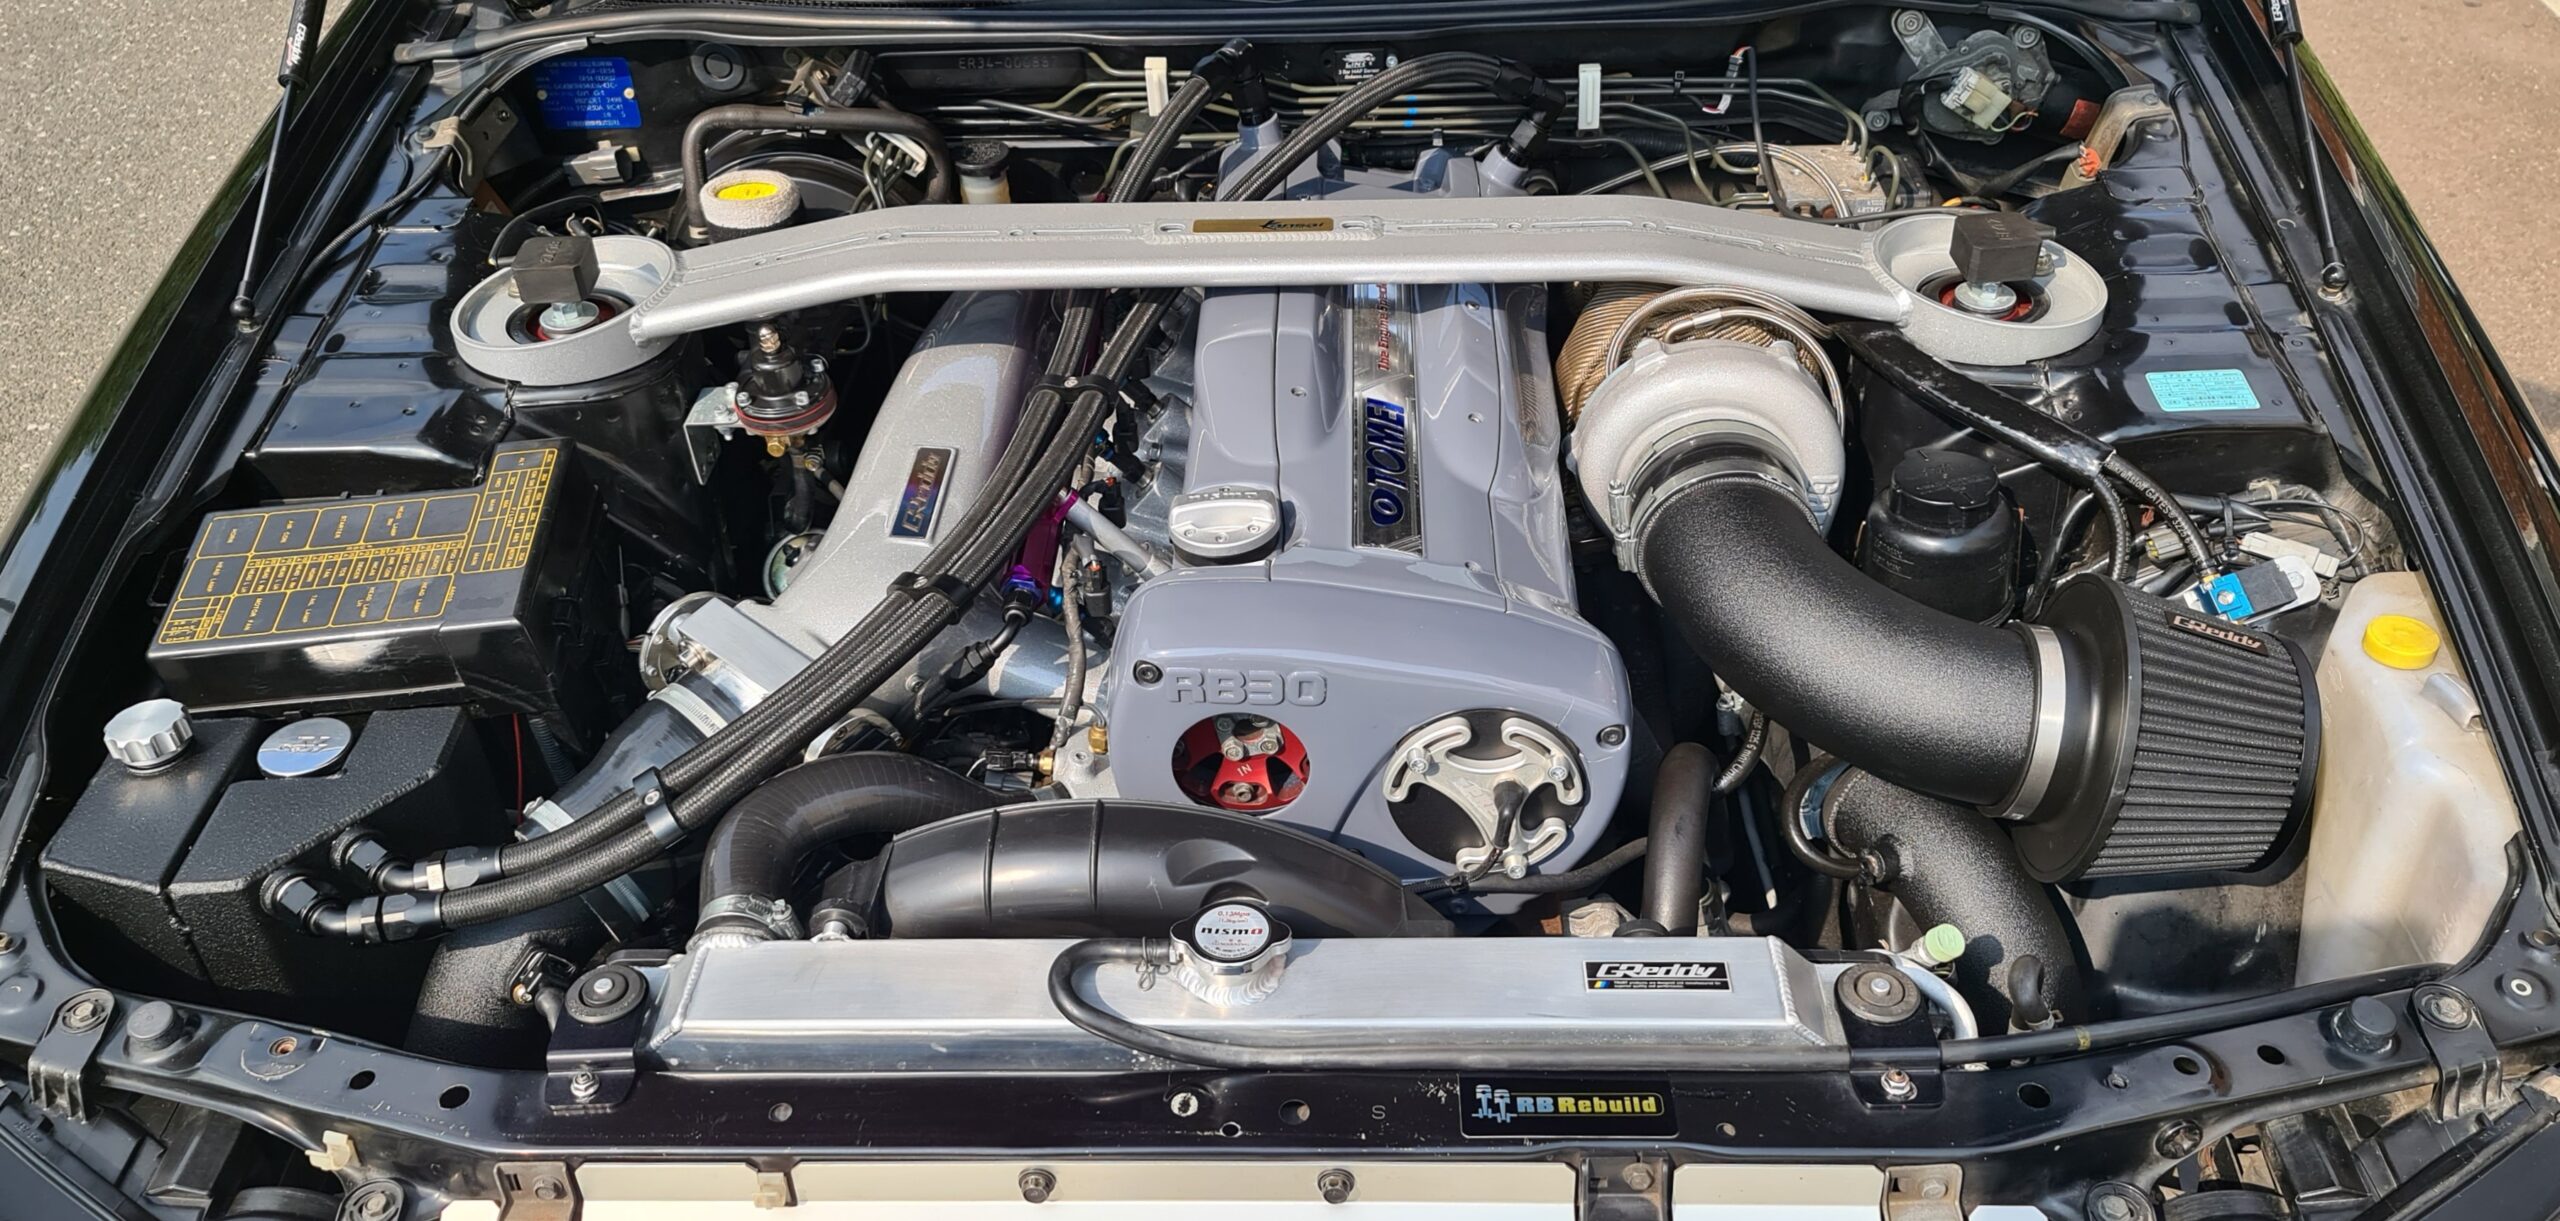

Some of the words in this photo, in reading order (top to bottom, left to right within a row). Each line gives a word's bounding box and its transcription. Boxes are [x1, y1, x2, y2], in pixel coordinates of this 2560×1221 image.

[2173, 615, 2262, 649] GReddy
[1166, 667, 1328, 707] RB30
[1237, 763, 1253, 777] IN
[1201, 927, 1263, 935] nismo
[1595, 963, 1717, 979] GReddy
[1517, 1096, 1555, 1113] RB
[1557, 1096, 1657, 1114] Rebuild
